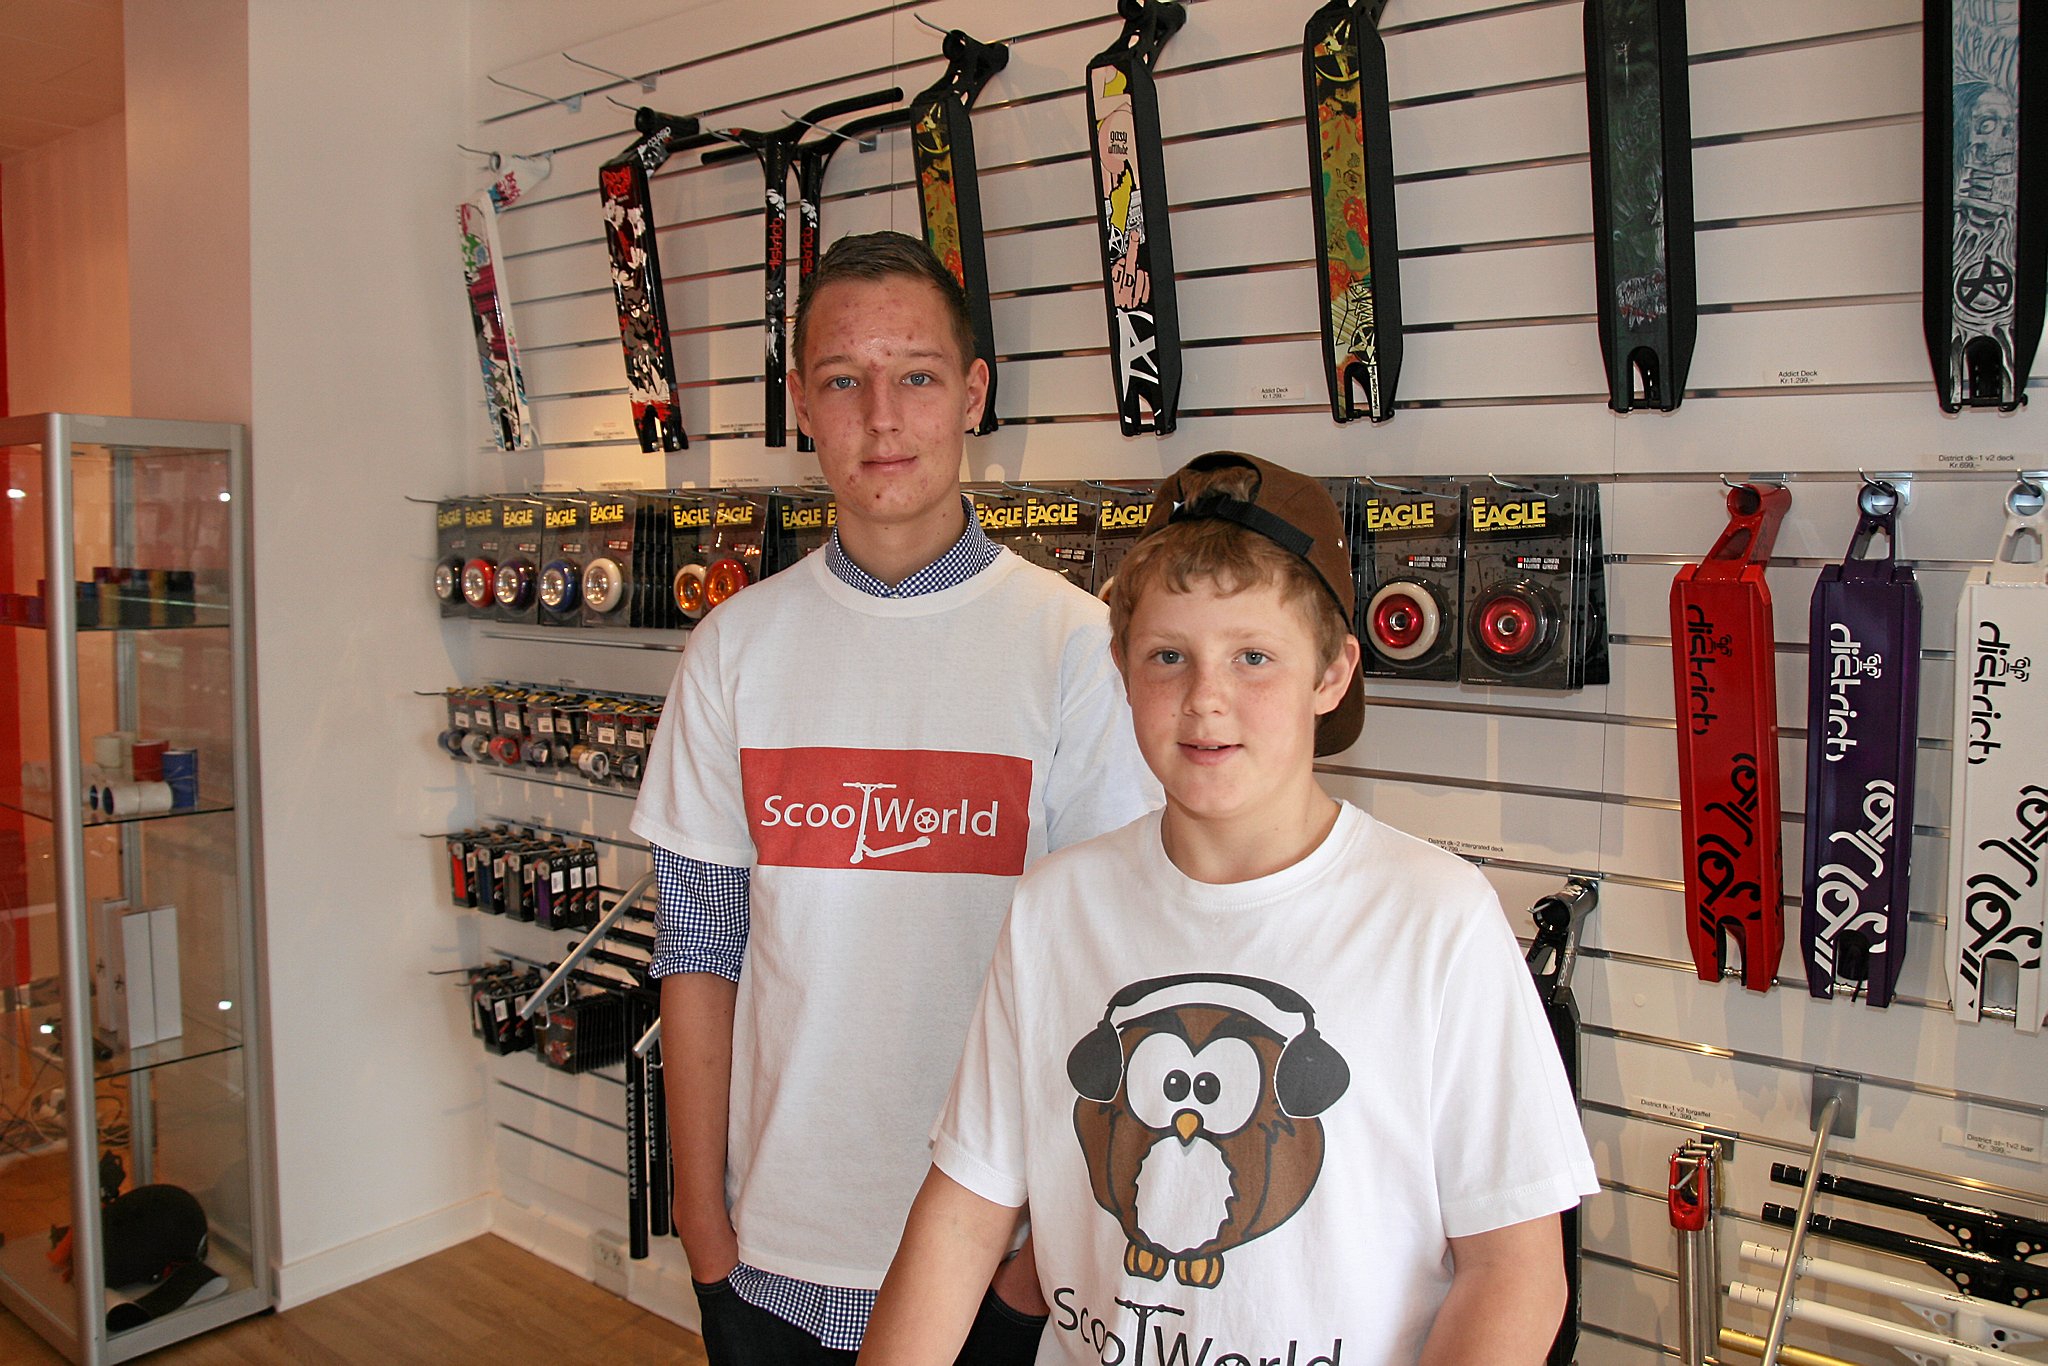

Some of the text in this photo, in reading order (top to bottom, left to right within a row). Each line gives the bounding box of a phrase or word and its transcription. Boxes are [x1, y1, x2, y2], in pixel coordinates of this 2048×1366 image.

[465, 508, 493, 527] EAGLE
[503, 508, 533, 526] EAGLE
[545, 508, 577, 527] EAGLE
[590, 503, 624, 522] EAGLE
[673, 507, 711, 526] EAGLE
[716, 505, 753, 523] EAGLE
[782, 508, 822, 528] EAGLE
[975, 506, 1023, 526] EAGLE
[1027, 503, 1078, 525] EAGLE
[1367, 502, 1434, 528] EAGLE
[1473, 501, 1546, 528] EAGLE
[1687, 604, 1718, 735] district
[1826, 623, 1861, 762] district
[1968, 621, 2010, 764] district
[1490, 845, 1504, 853] deck
[1640, 1098, 1662, 1108] District
[1676, 1105, 1685, 1113] v2
[1685, 1108, 1711, 1118] forgaffel
[1967, 1134, 1992, 1145] District
[2020, 1144, 2034, 1153] bar
